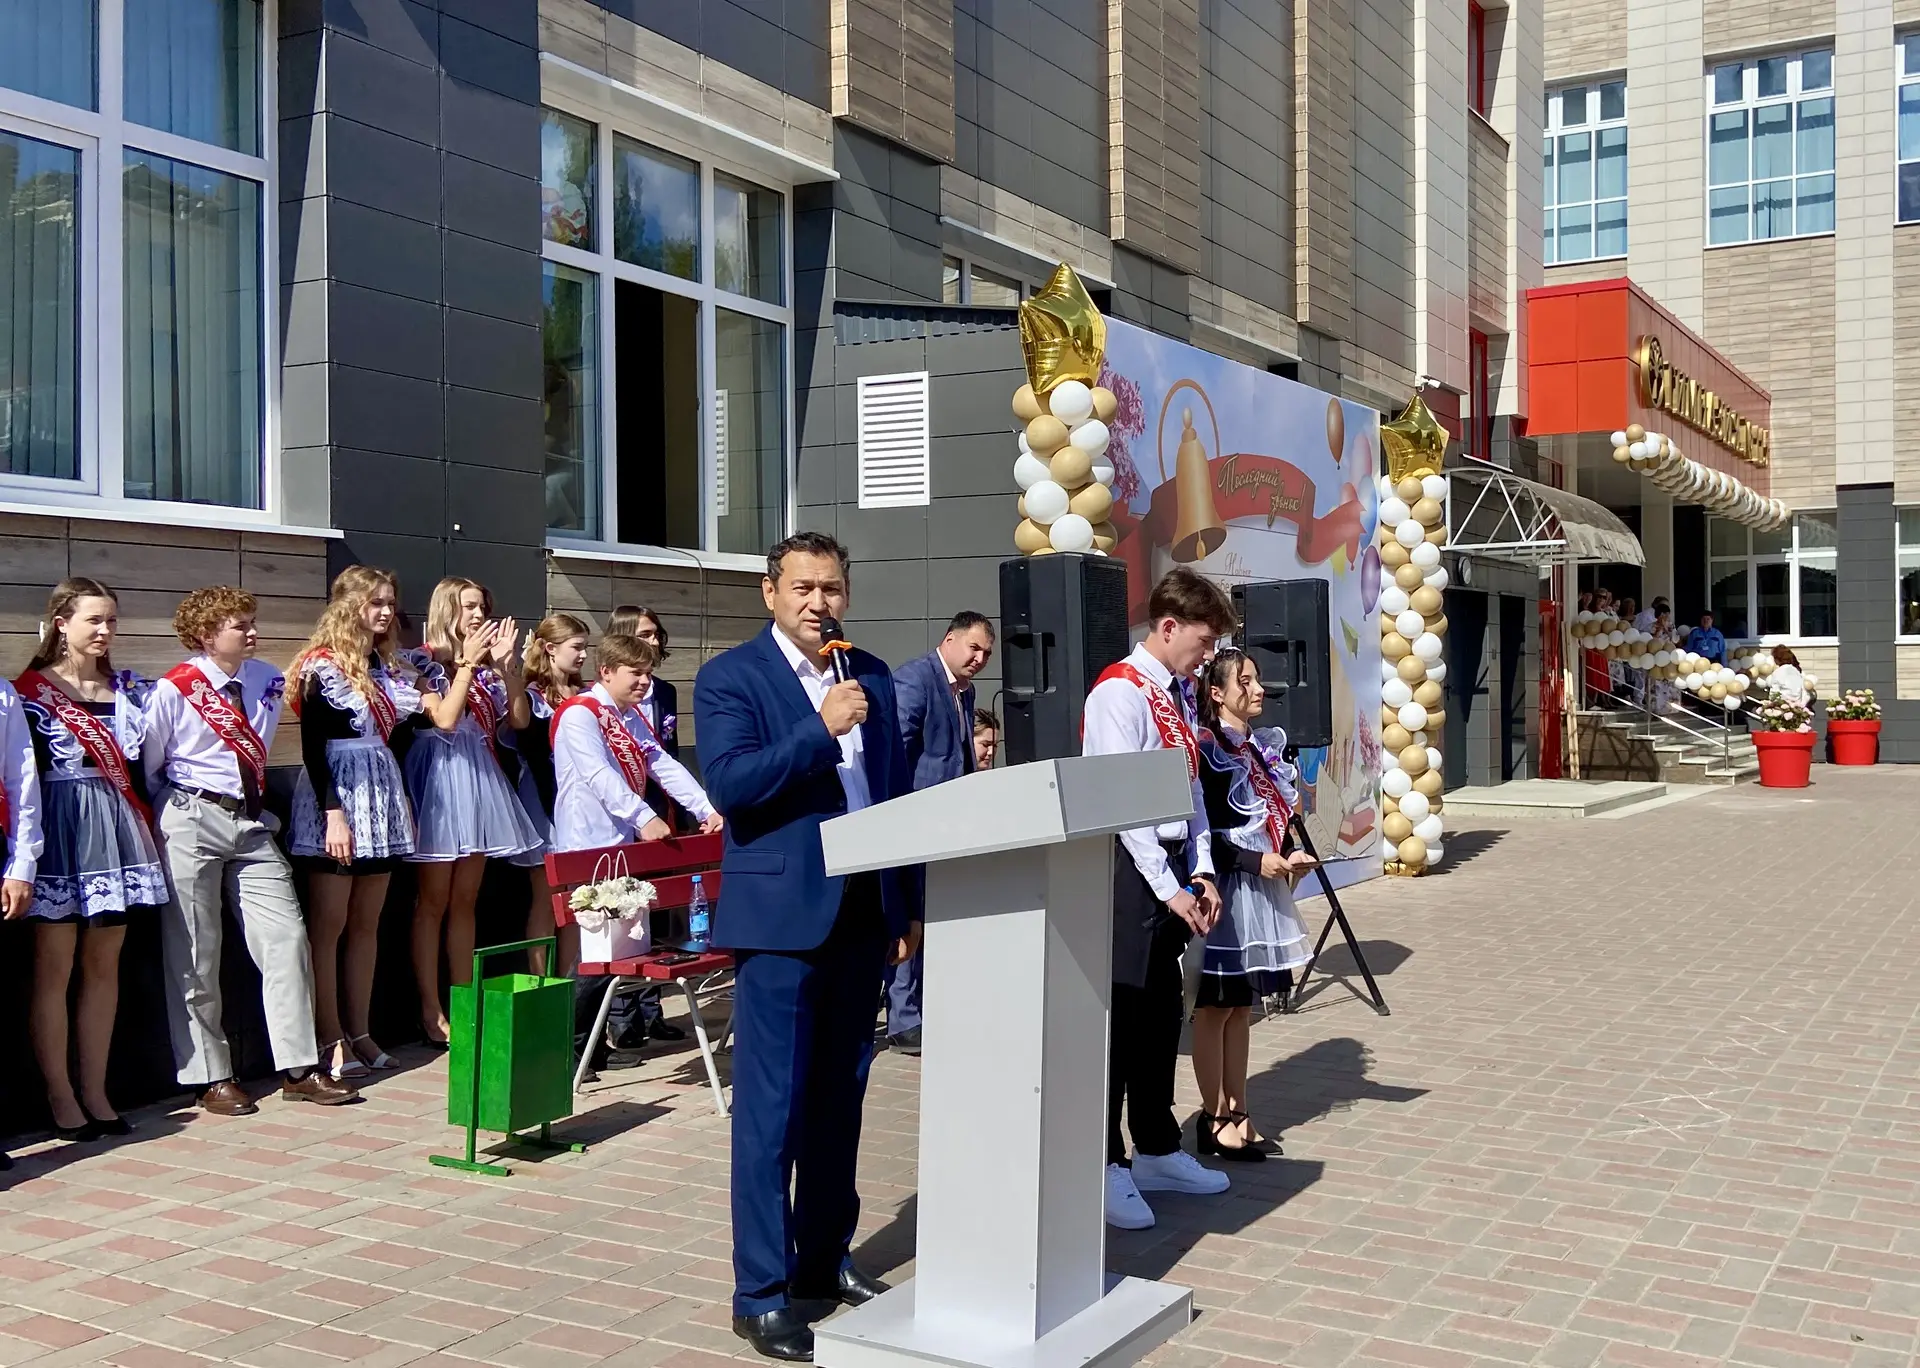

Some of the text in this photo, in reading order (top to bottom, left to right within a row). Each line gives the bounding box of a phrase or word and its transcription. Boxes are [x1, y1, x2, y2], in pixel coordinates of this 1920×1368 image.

[1217, 453, 1280, 499] Последний
[55, 705, 116, 769] Выпускник
[1252, 774, 1285, 841] Выпускни
